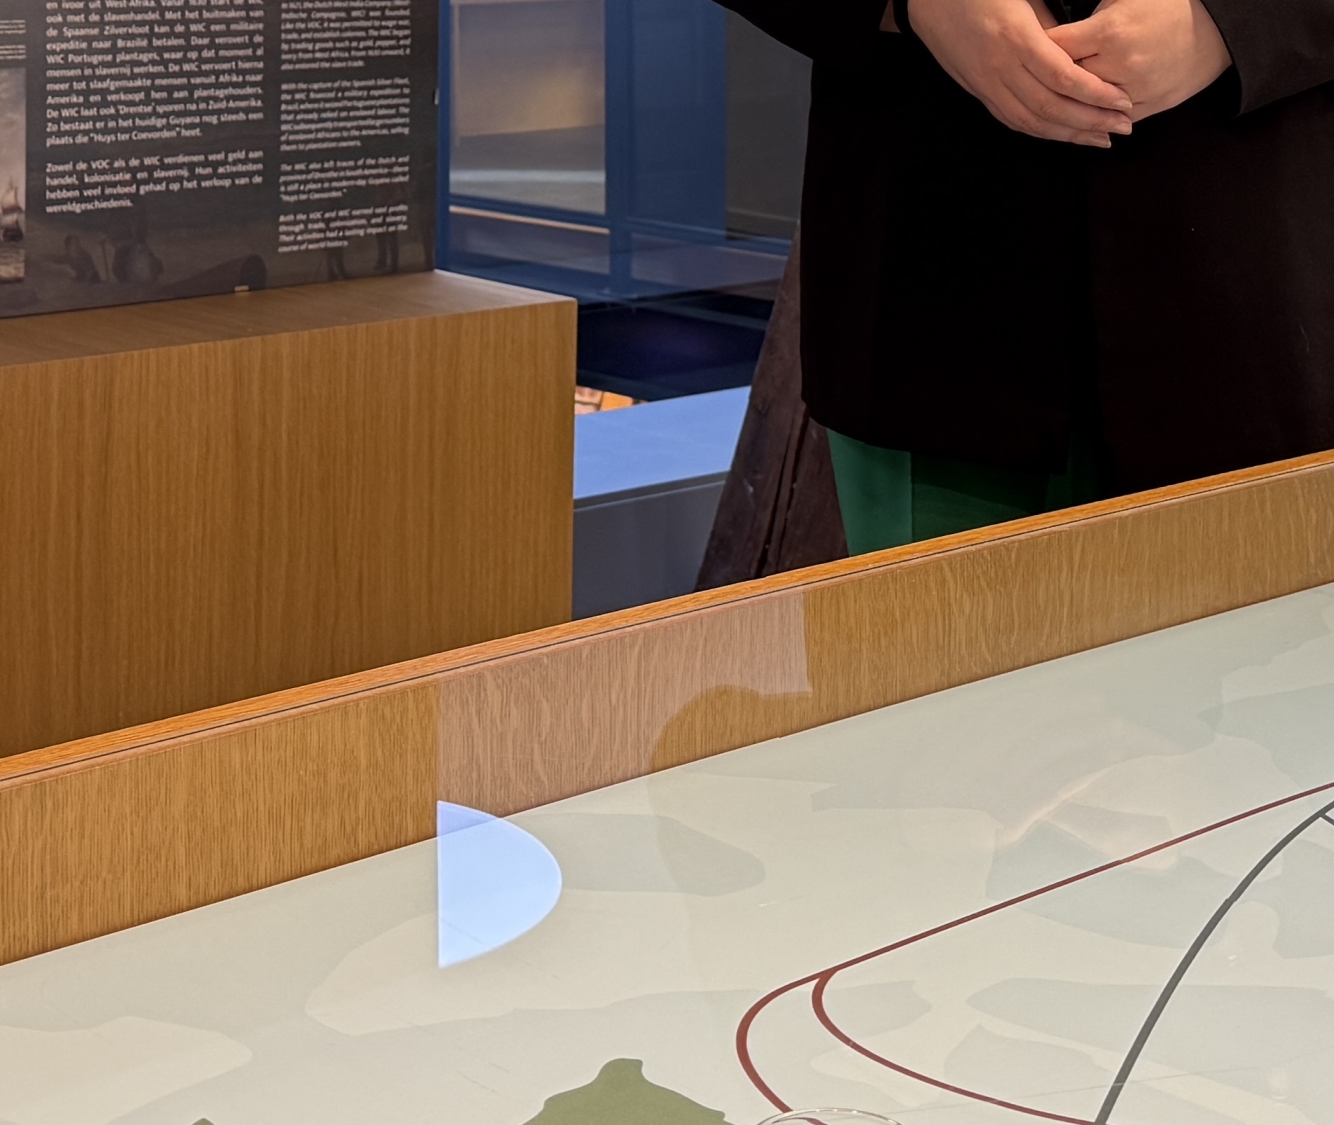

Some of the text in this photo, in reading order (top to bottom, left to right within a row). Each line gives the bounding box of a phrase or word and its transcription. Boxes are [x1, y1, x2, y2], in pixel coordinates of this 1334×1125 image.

[45, 2, 58, 10] en
[61, 0, 85, 10] ivoor
[88, 0, 102, 9] uit
[46, 93, 84, 105] Amerika
[89, 94, 102, 103] en
[106, 91, 145, 103] verkoopt
[150, 89, 168, 99] hen
[172, 90, 189, 99] aan
[46, 135, 74, 148] plaats
[74, 133, 89, 144] die
[116, 132, 130, 141] ter
[180, 127, 202, 137] heet.
[45, 174, 79, 186] handel,
[83, 172, 132, 183] kolonisatie
[136, 171, 149, 180] en
[194, 166, 213, 175] Hun
[217, 162, 264, 174] activiteiten
[45, 198, 133, 214] wereldgeschiedenis.
